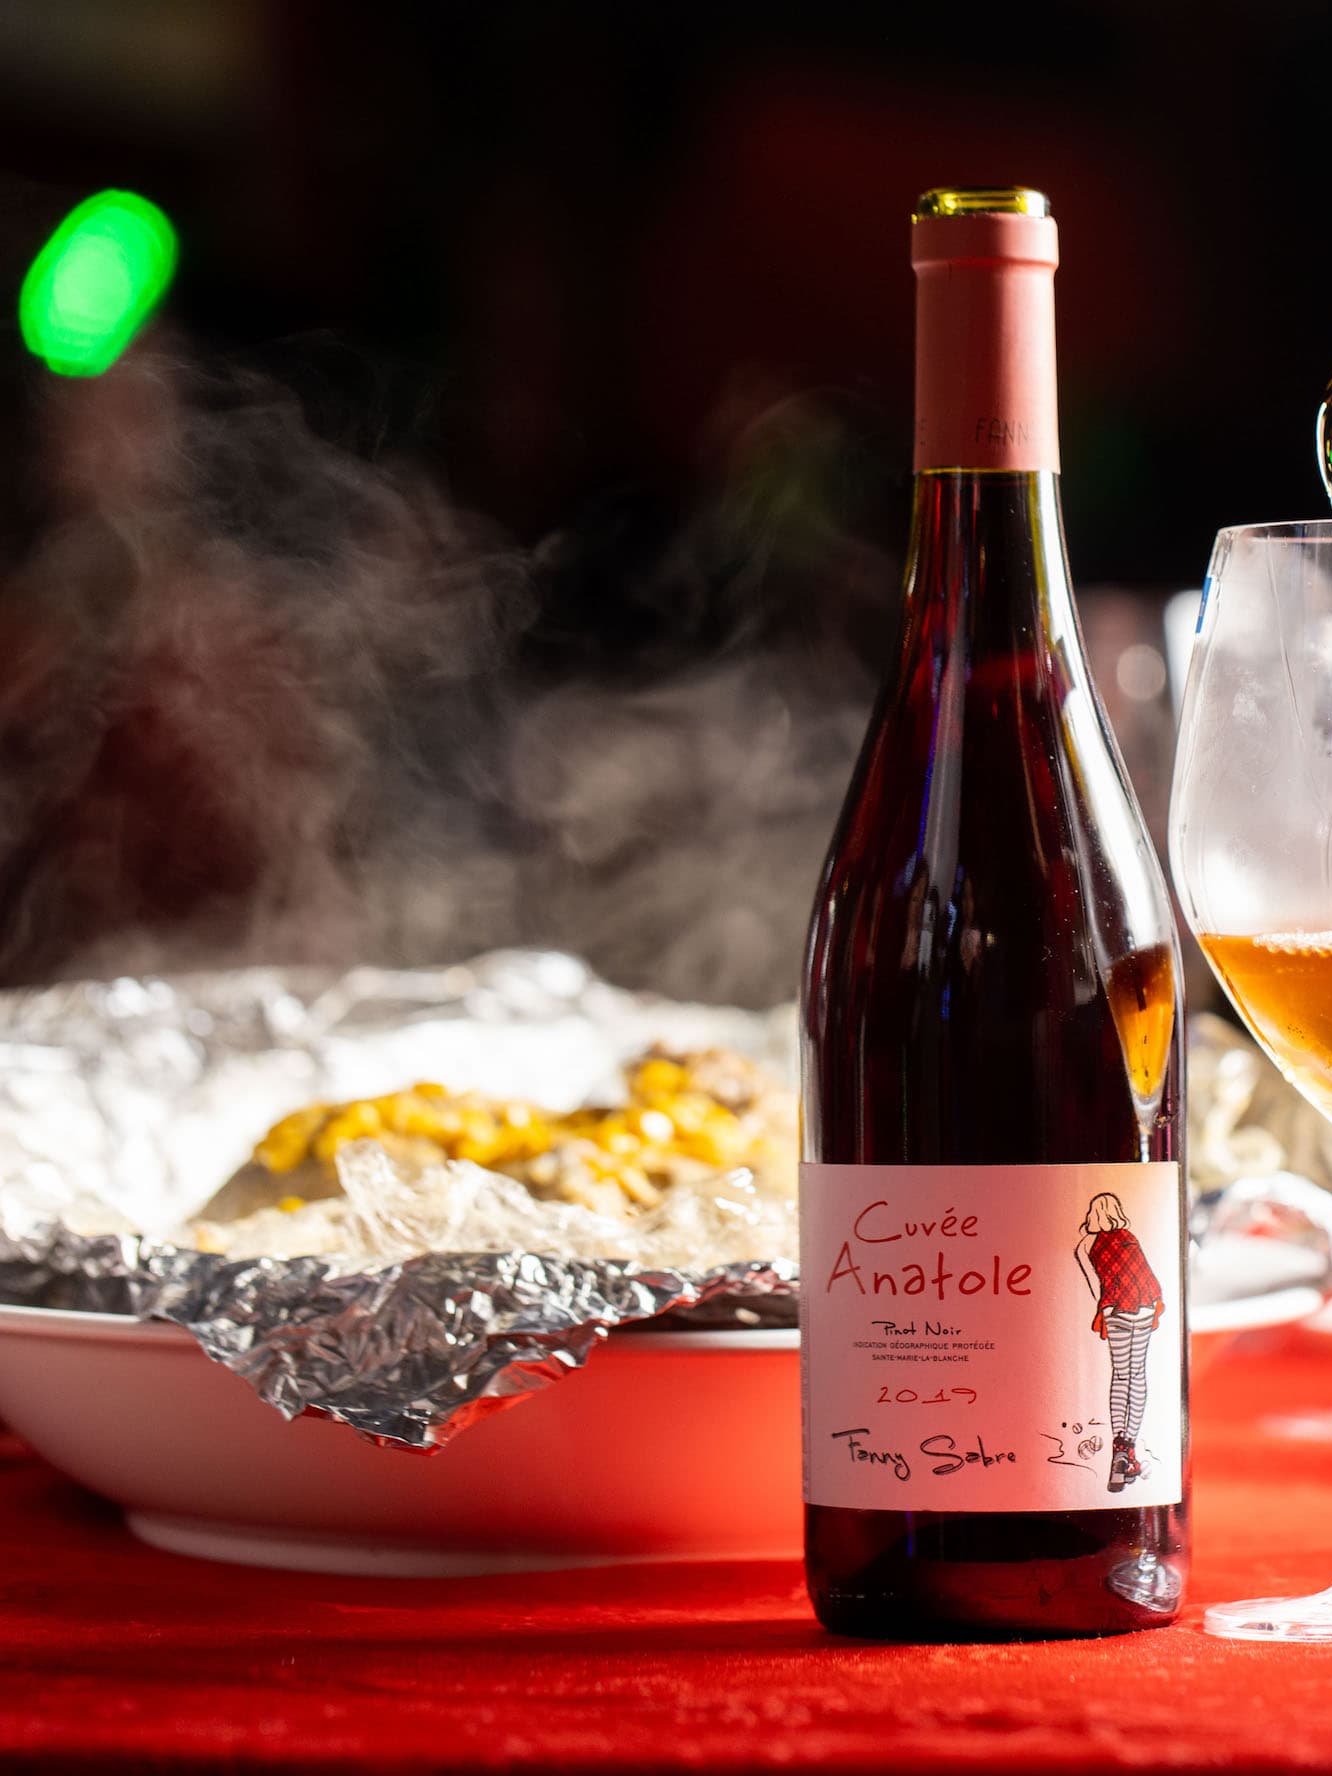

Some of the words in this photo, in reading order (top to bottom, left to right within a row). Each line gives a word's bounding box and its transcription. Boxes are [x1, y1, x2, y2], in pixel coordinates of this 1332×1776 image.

[854, 1201, 978, 1243] Cuvée
[827, 1241, 1032, 1300] Anatole
[871, 1321, 917, 1336] Pinot
[925, 1321, 962, 1336] Noir
[889, 1340, 949, 1350] GÉOGRAPHIQUE
[952, 1340, 995, 1350] PROTÉGÉE
[876, 1386, 977, 1405] 2019
[831, 1428, 911, 1482] Fanny
[919, 1434, 1016, 1476] Sabre
